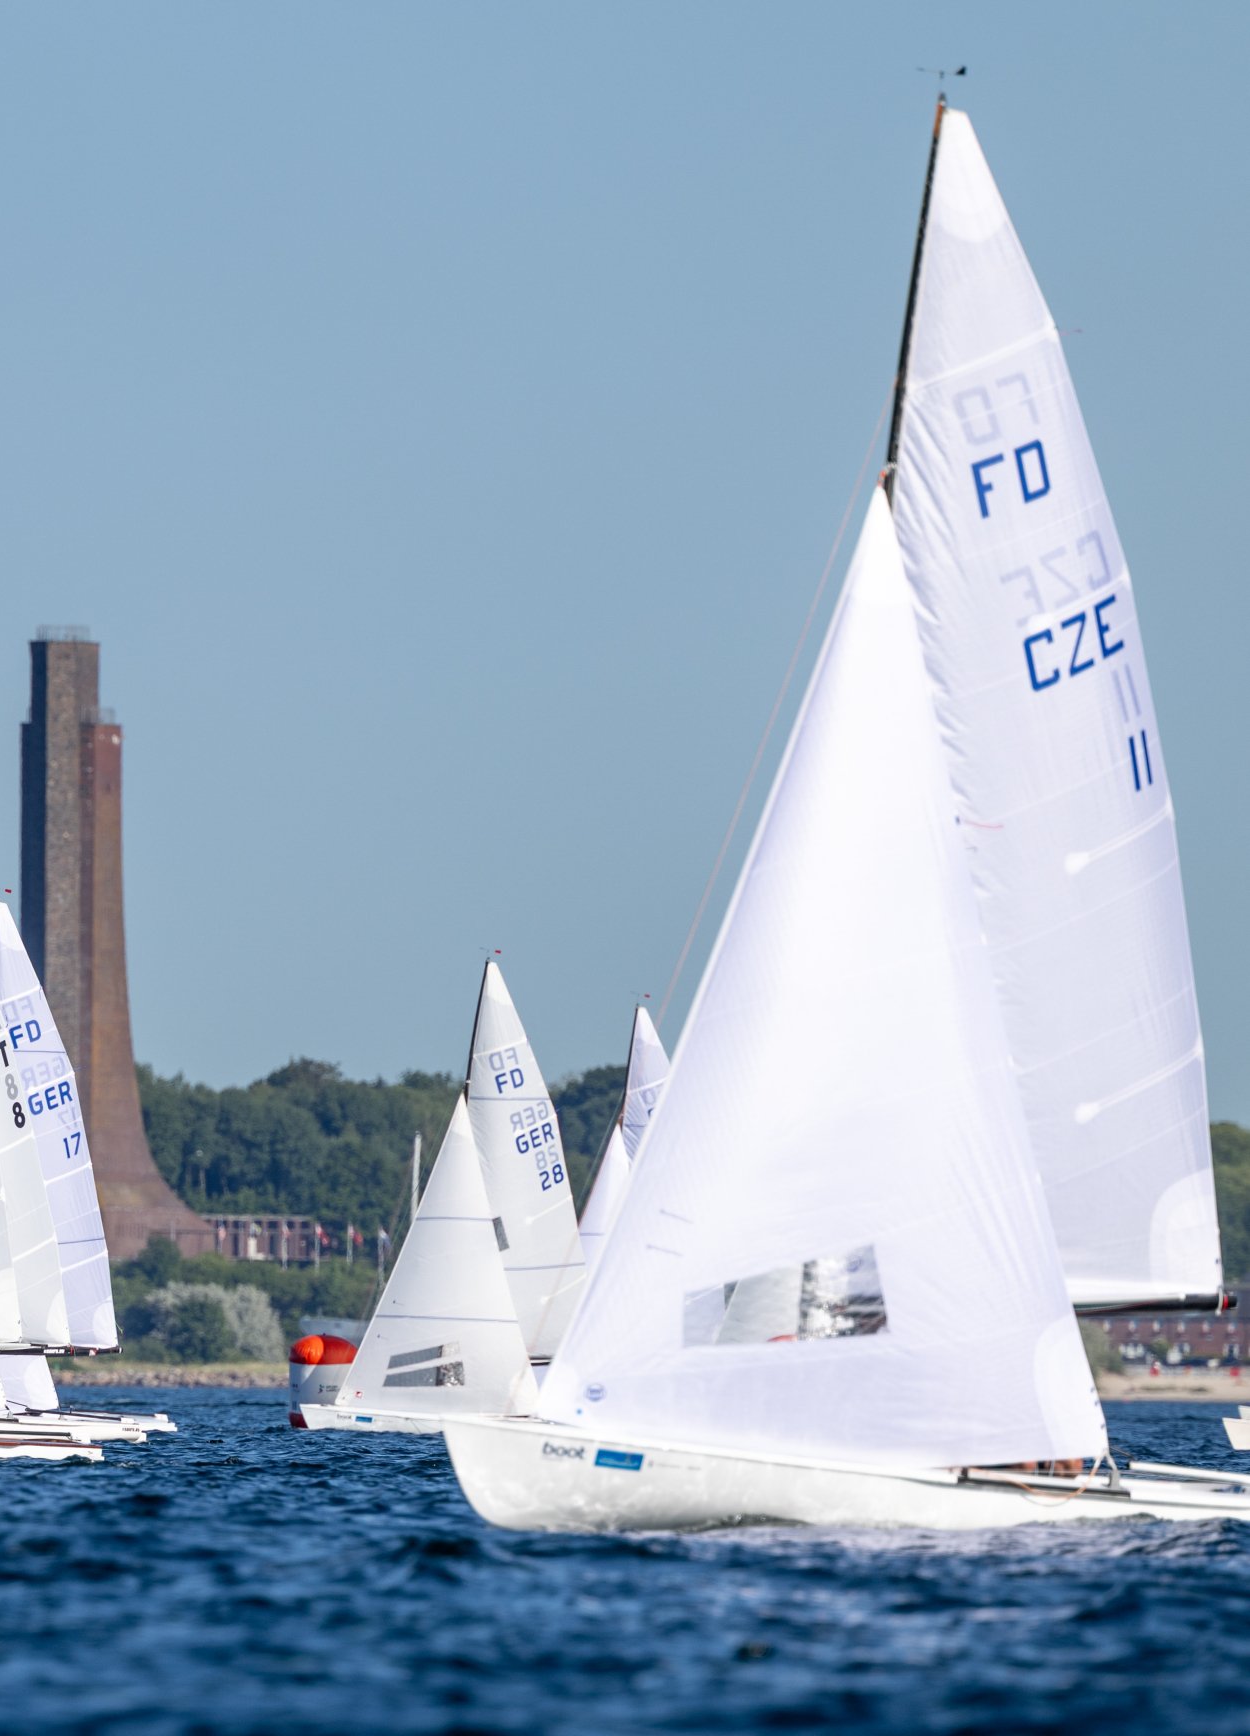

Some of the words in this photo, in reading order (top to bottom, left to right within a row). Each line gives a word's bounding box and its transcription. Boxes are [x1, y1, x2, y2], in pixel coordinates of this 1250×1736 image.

[971, 439, 1051, 519] FD
[1023, 594, 1125, 692] CZE
[1128, 730, 1153, 792] 11
[9, 1019, 41, 1049] FD
[495, 1068, 524, 1094] FD
[28, 1081, 73, 1116] GER
[12, 1102, 25, 1128] 8
[63, 1132, 81, 1159] 17
[516, 1123, 555, 1154] GER
[539, 1164, 564, 1191] 28
[542, 1442, 585, 1459] boot
